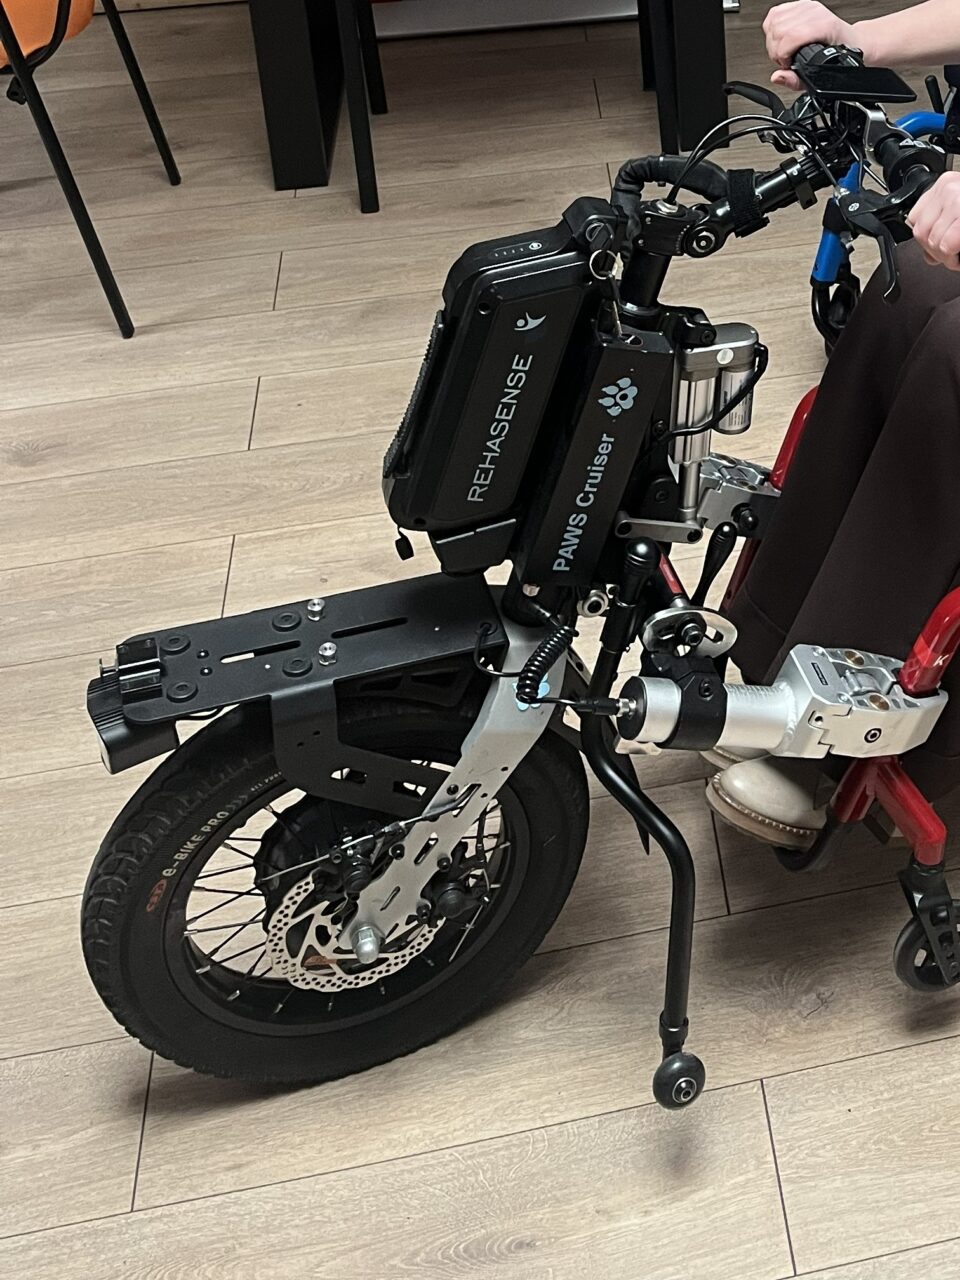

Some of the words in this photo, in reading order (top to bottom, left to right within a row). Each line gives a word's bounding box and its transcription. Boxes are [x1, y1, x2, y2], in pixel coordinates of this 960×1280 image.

[467, 354, 533, 502] REHASENSE
[552, 513, 589, 571] PAWS
[575, 433, 616, 507] Cruiser
[162, 834, 206, 877] e-BIKE
[201, 811, 230, 833] PRO
